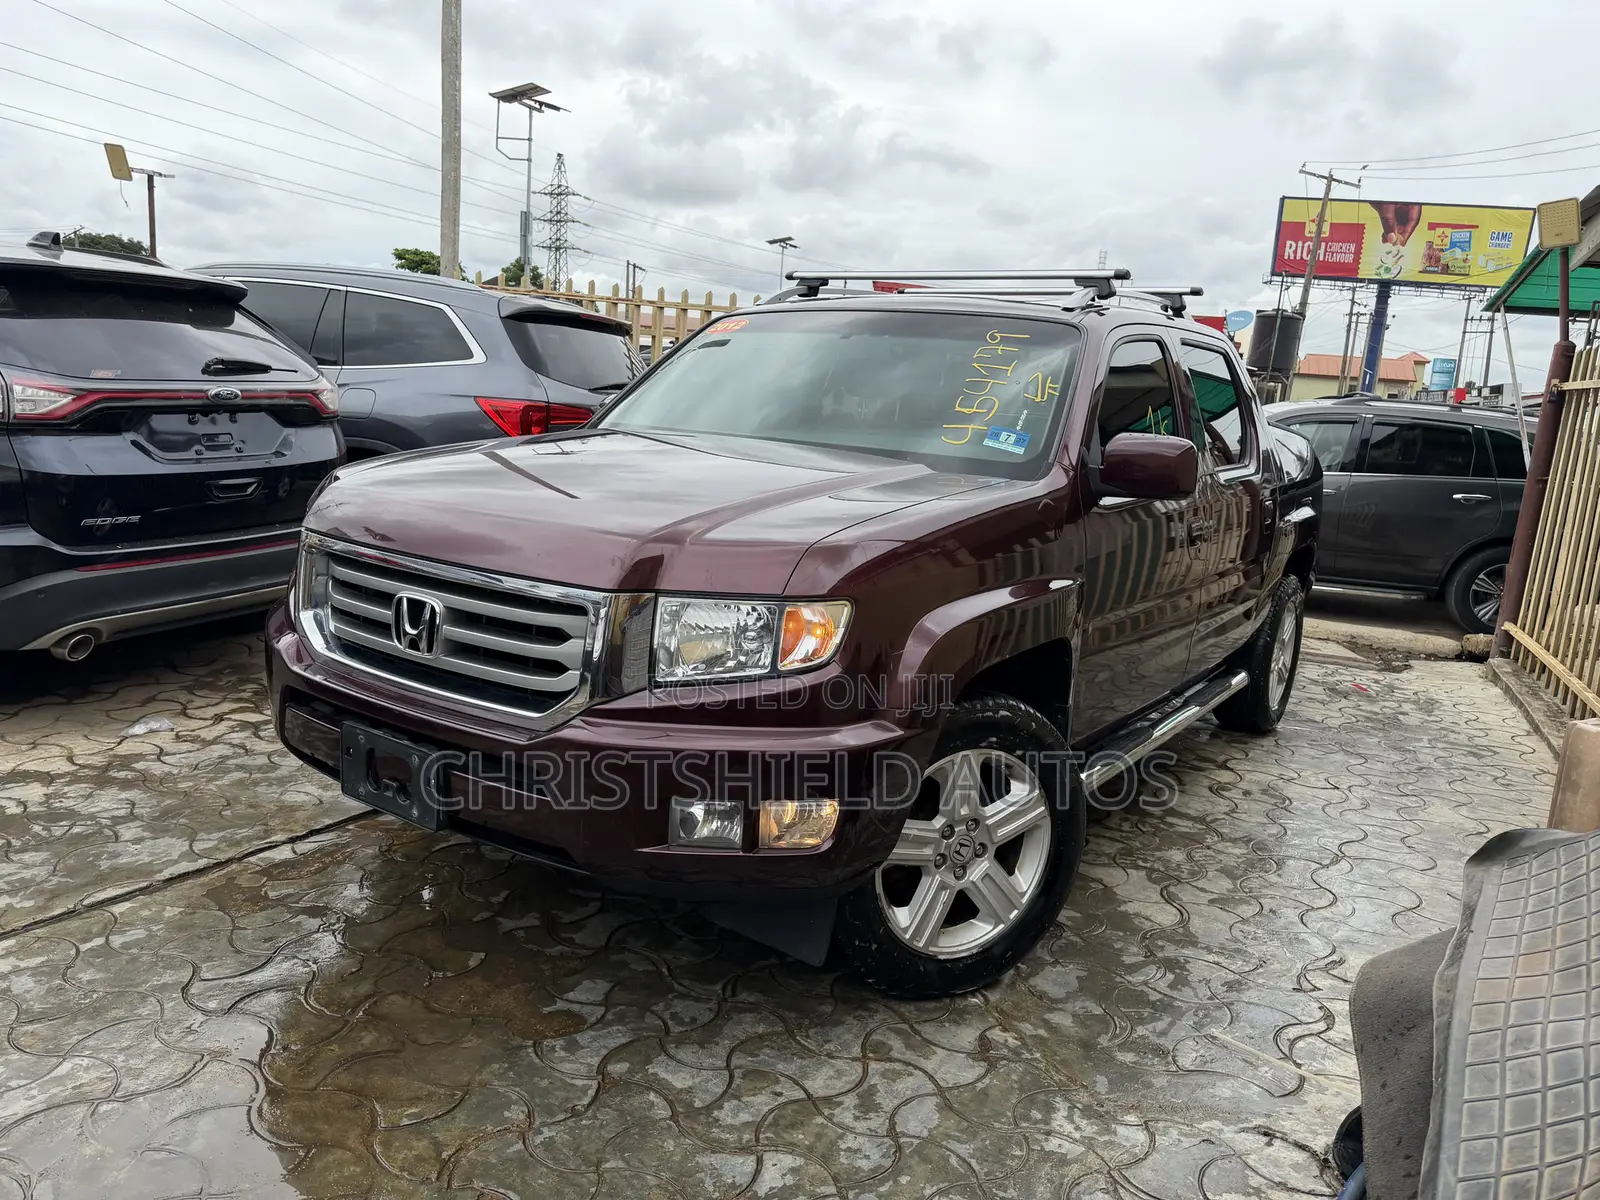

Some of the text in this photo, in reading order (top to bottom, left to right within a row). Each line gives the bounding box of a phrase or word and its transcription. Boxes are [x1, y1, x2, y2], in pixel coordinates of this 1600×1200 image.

[1284, 240, 1326, 261] RICH
[1327, 242, 1356, 254] CHICKEN
[1325, 252, 1354, 263] FLAVOUR
[217, 390, 236, 399] Ford
[1004, 434, 1012, 442] 7
[80, 515, 142, 526] EDGE
